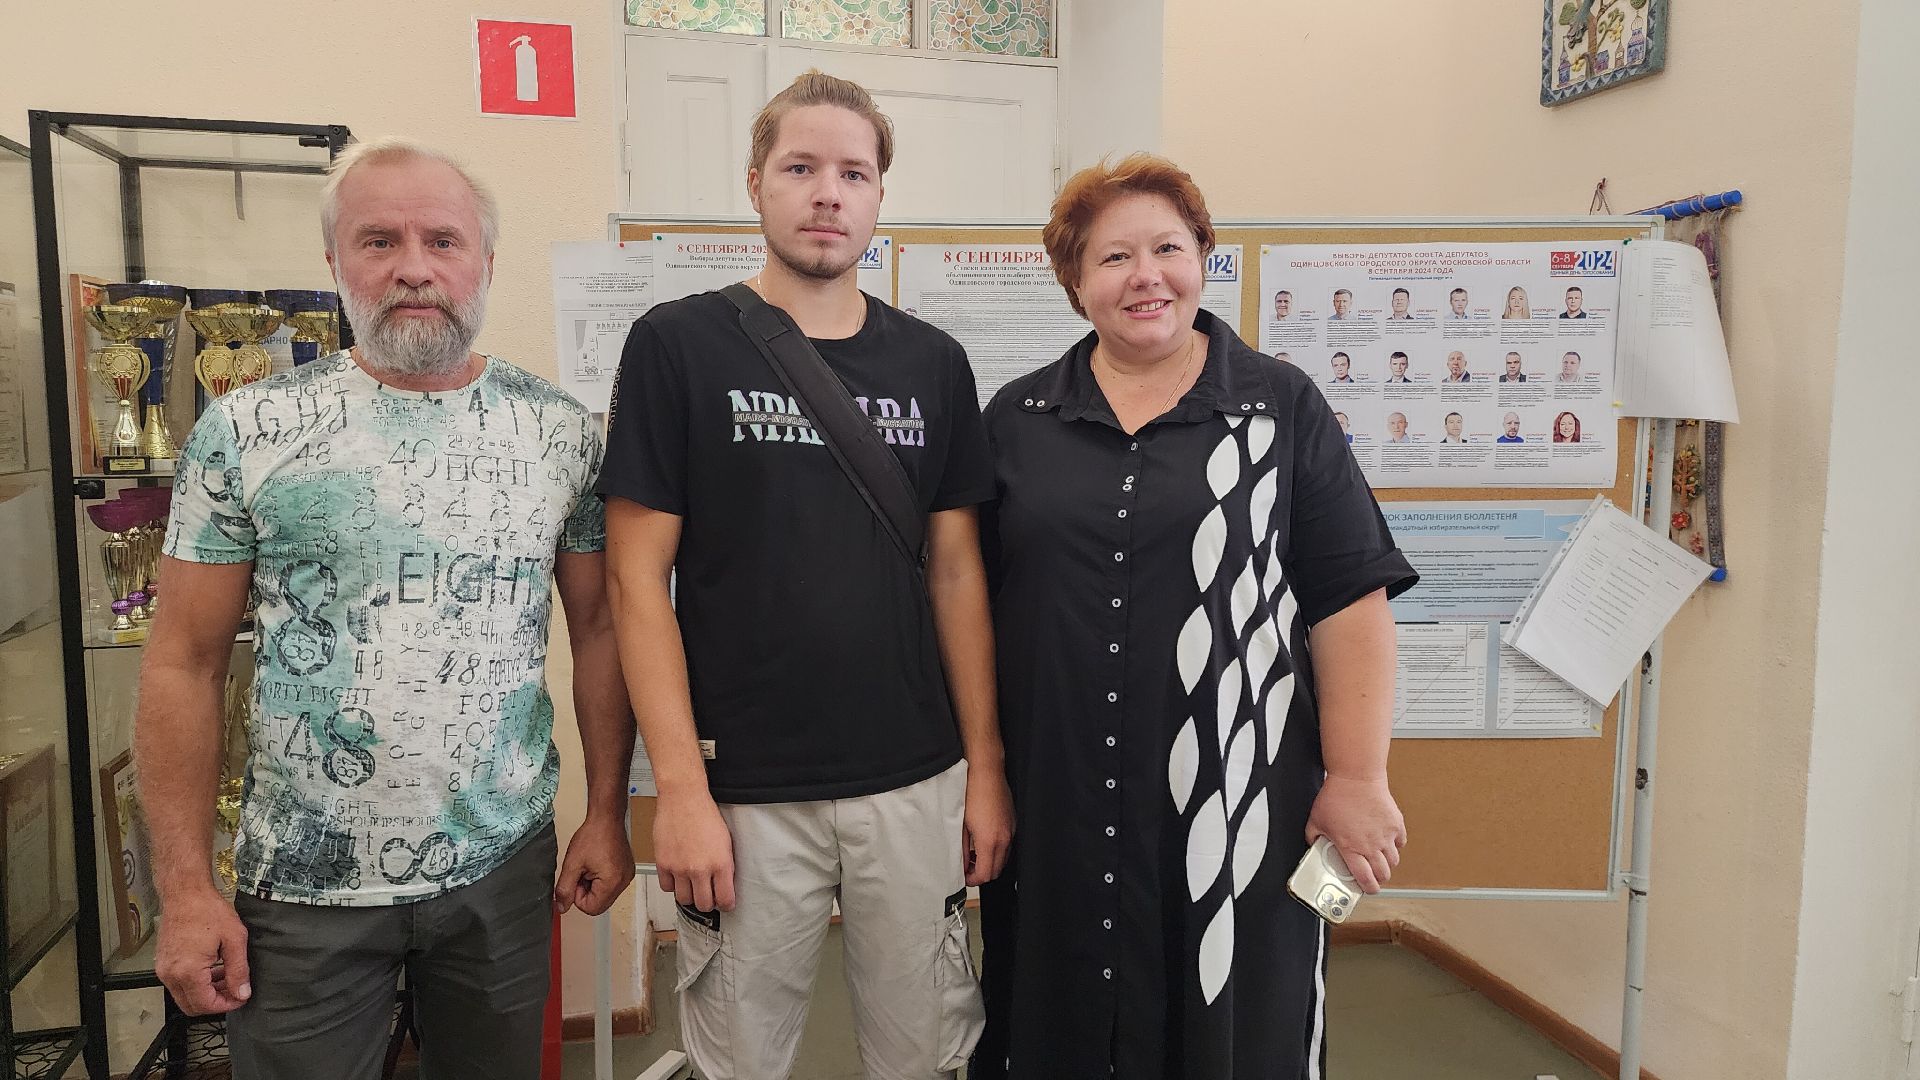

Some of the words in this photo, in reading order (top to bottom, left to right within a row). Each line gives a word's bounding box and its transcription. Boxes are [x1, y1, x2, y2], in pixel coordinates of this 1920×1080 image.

[678, 244, 683, 252] 8
[686, 244, 748, 253] СЕНТЯБРЯ
[751, 245, 767, 253] 202
[944, 251, 952, 263] 8
[956, 251, 1043, 263] СЕНТЯБРЯ
[1206, 254, 1232, 273] 024
[1552, 254, 1570, 263] 6-8
[1574, 251, 1613, 270] 2024
[285, 377, 346, 398] EIGHT
[295, 442, 332, 467] 48
[444, 452, 537, 487] EIGHT
[398, 552, 541, 611] EIGHT
[414, 622, 428, 638] &
[432, 622, 441, 636] 8
[284, 706, 376, 789] 48
